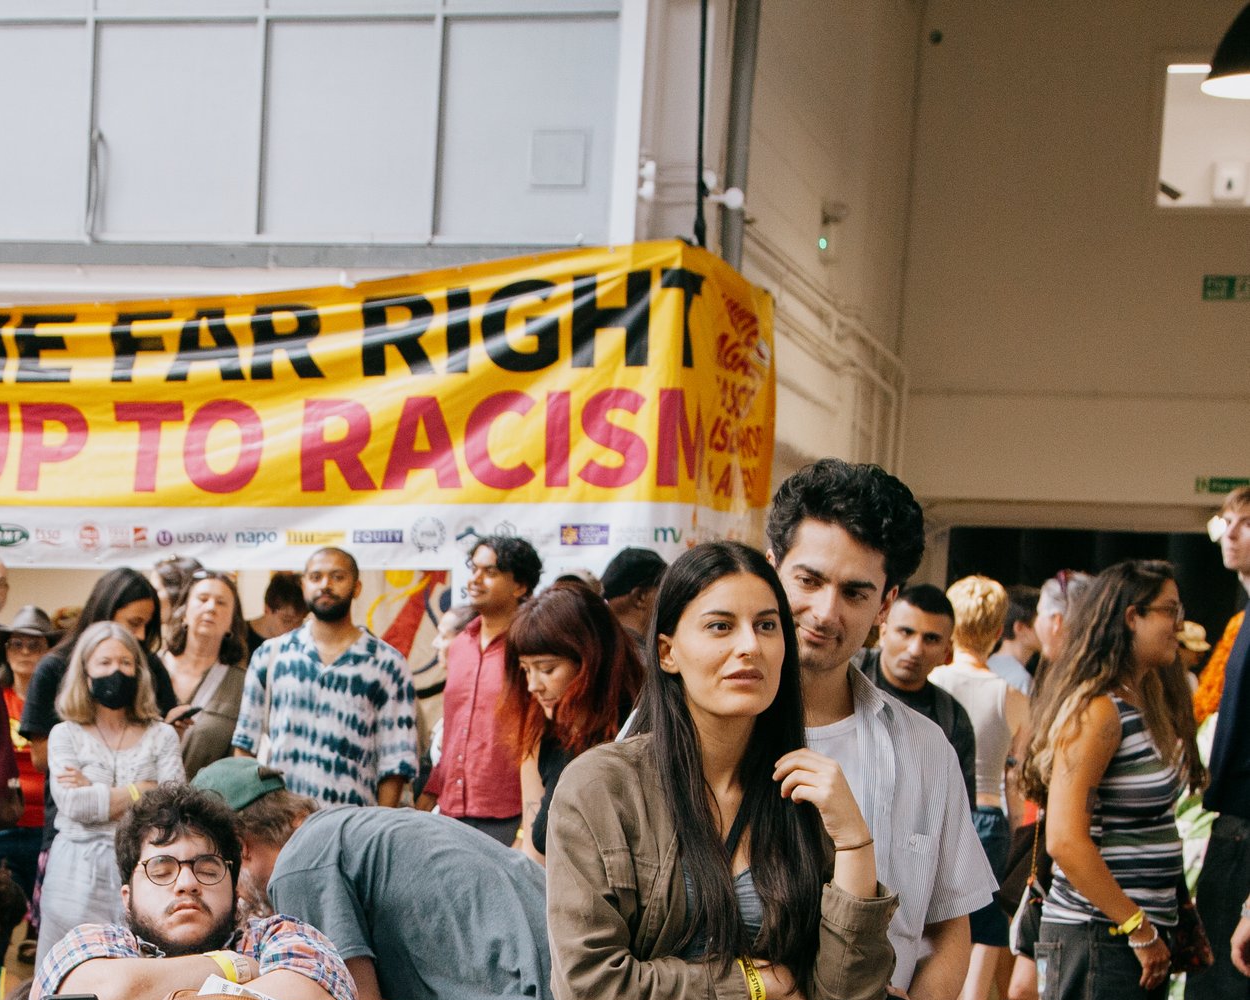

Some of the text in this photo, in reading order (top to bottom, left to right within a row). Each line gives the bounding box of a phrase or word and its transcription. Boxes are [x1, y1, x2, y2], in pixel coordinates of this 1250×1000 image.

[109, 303, 325, 382] FAR
[361, 267, 706, 376] RIGHT
[113, 399, 264, 494] TO
[299, 387, 705, 493] RACISM
